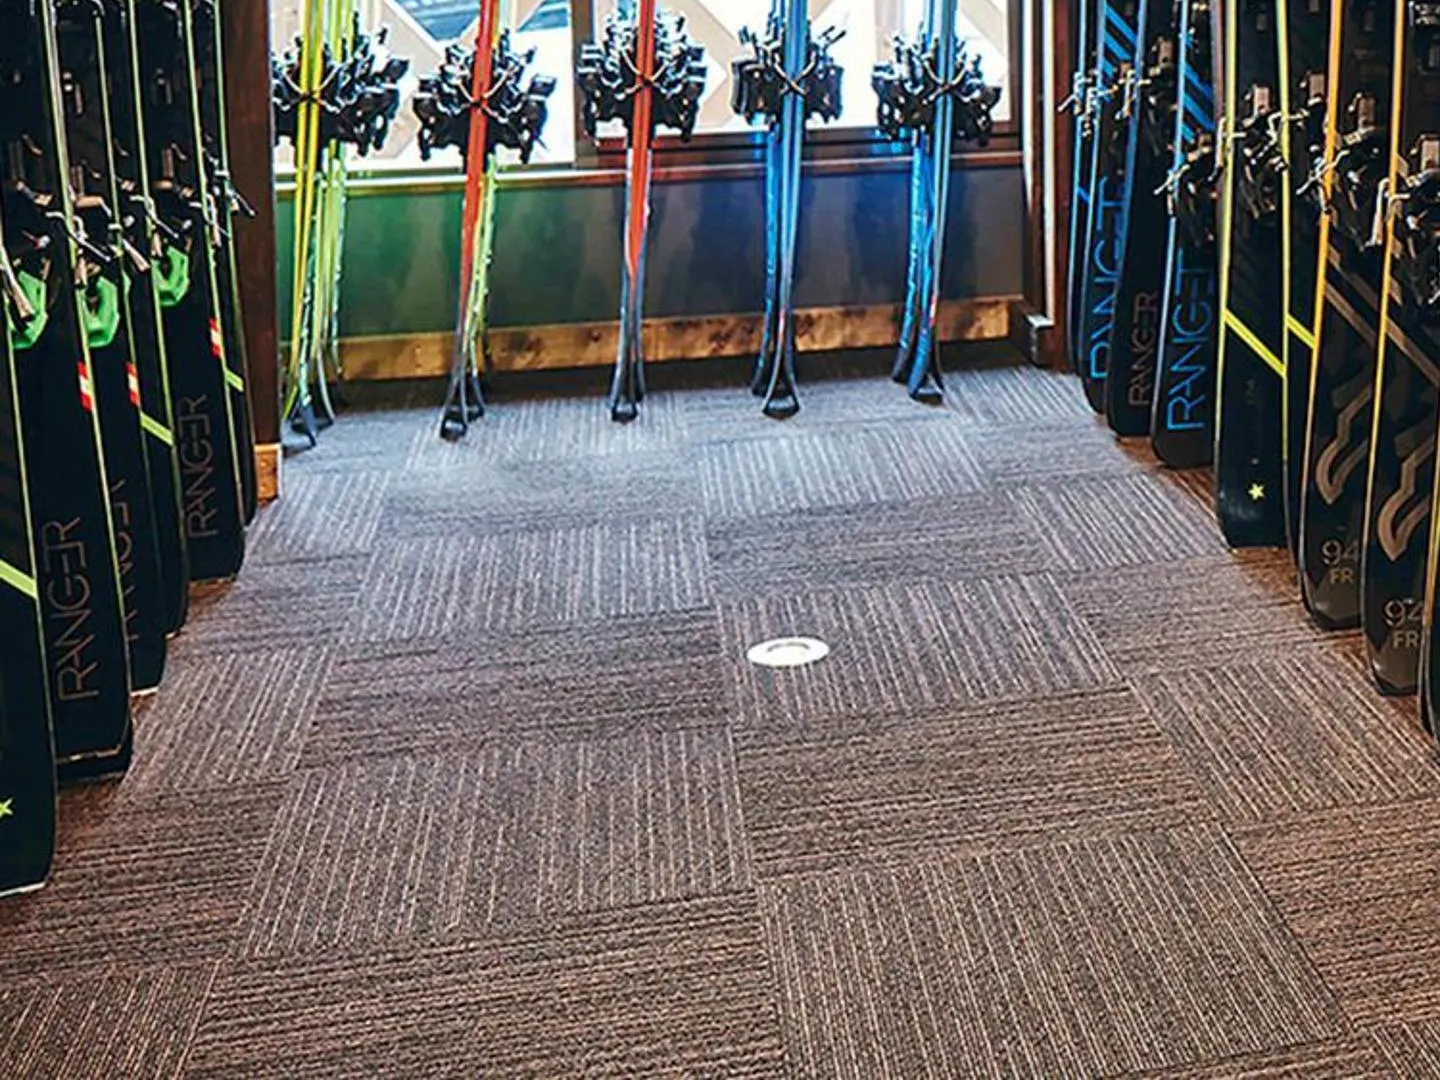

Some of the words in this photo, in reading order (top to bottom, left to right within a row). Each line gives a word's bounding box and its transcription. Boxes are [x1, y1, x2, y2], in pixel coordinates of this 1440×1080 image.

[1128, 291, 1158, 407] RANGER
[180, 392, 219, 540] RANGER
[41, 516, 99, 703] RANGER
[1393, 630, 1420, 649] FR
